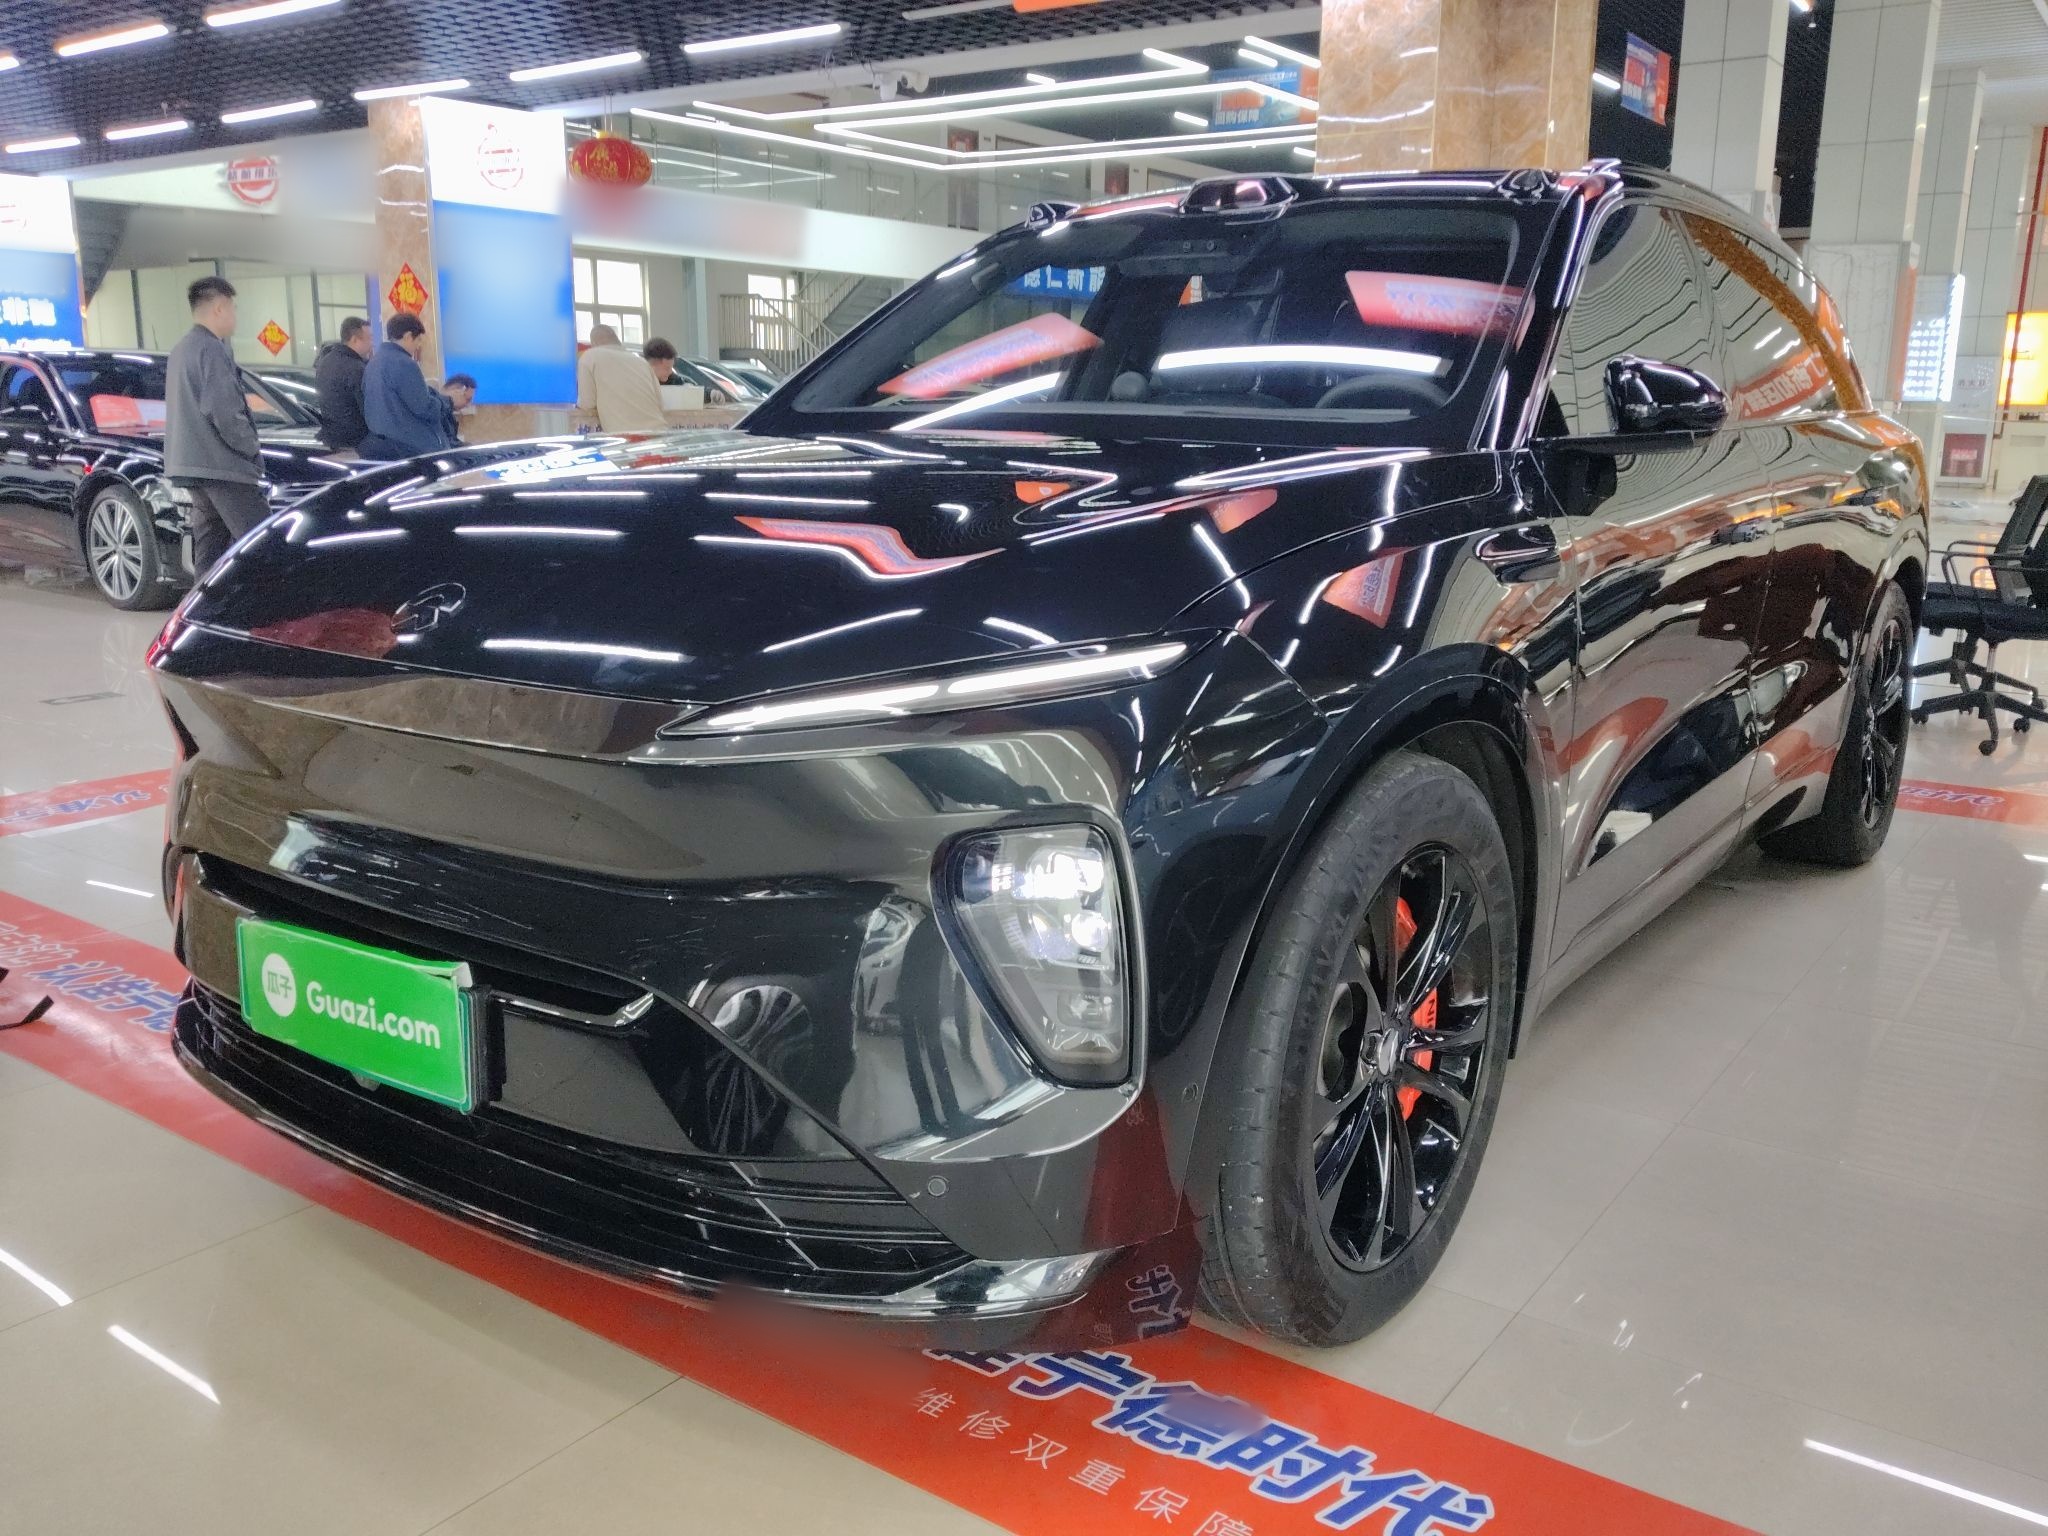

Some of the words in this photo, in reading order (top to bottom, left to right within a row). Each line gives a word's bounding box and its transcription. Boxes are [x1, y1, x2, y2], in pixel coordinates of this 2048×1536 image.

[267, 970, 293, 999] 瓜子
[306, 980, 441, 1050] Guazi.com
[910, 1386, 1255, 1536] 维修双重保障
